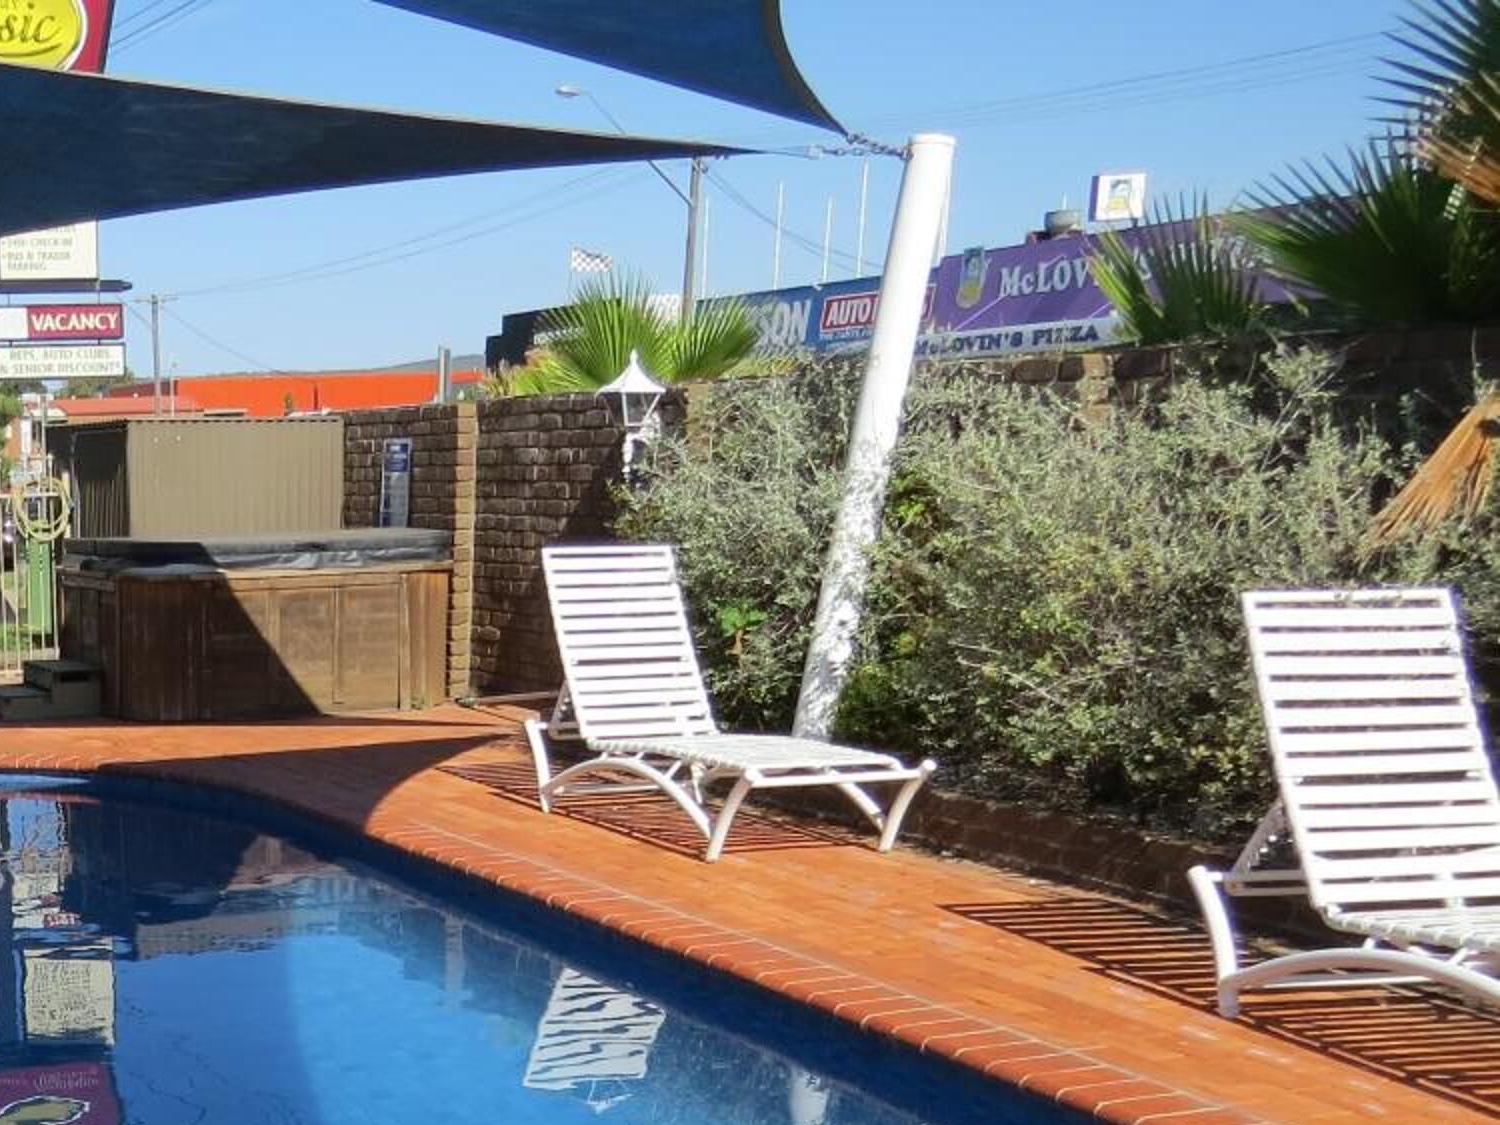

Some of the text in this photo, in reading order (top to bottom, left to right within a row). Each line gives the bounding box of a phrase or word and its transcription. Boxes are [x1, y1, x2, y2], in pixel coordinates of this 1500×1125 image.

[31, 312, 118, 331] VACANCY
[826, 297, 871, 327] AUTO
[1032, 324, 1099, 346] PIZZA
[13, 362, 53, 374] SENIOR
